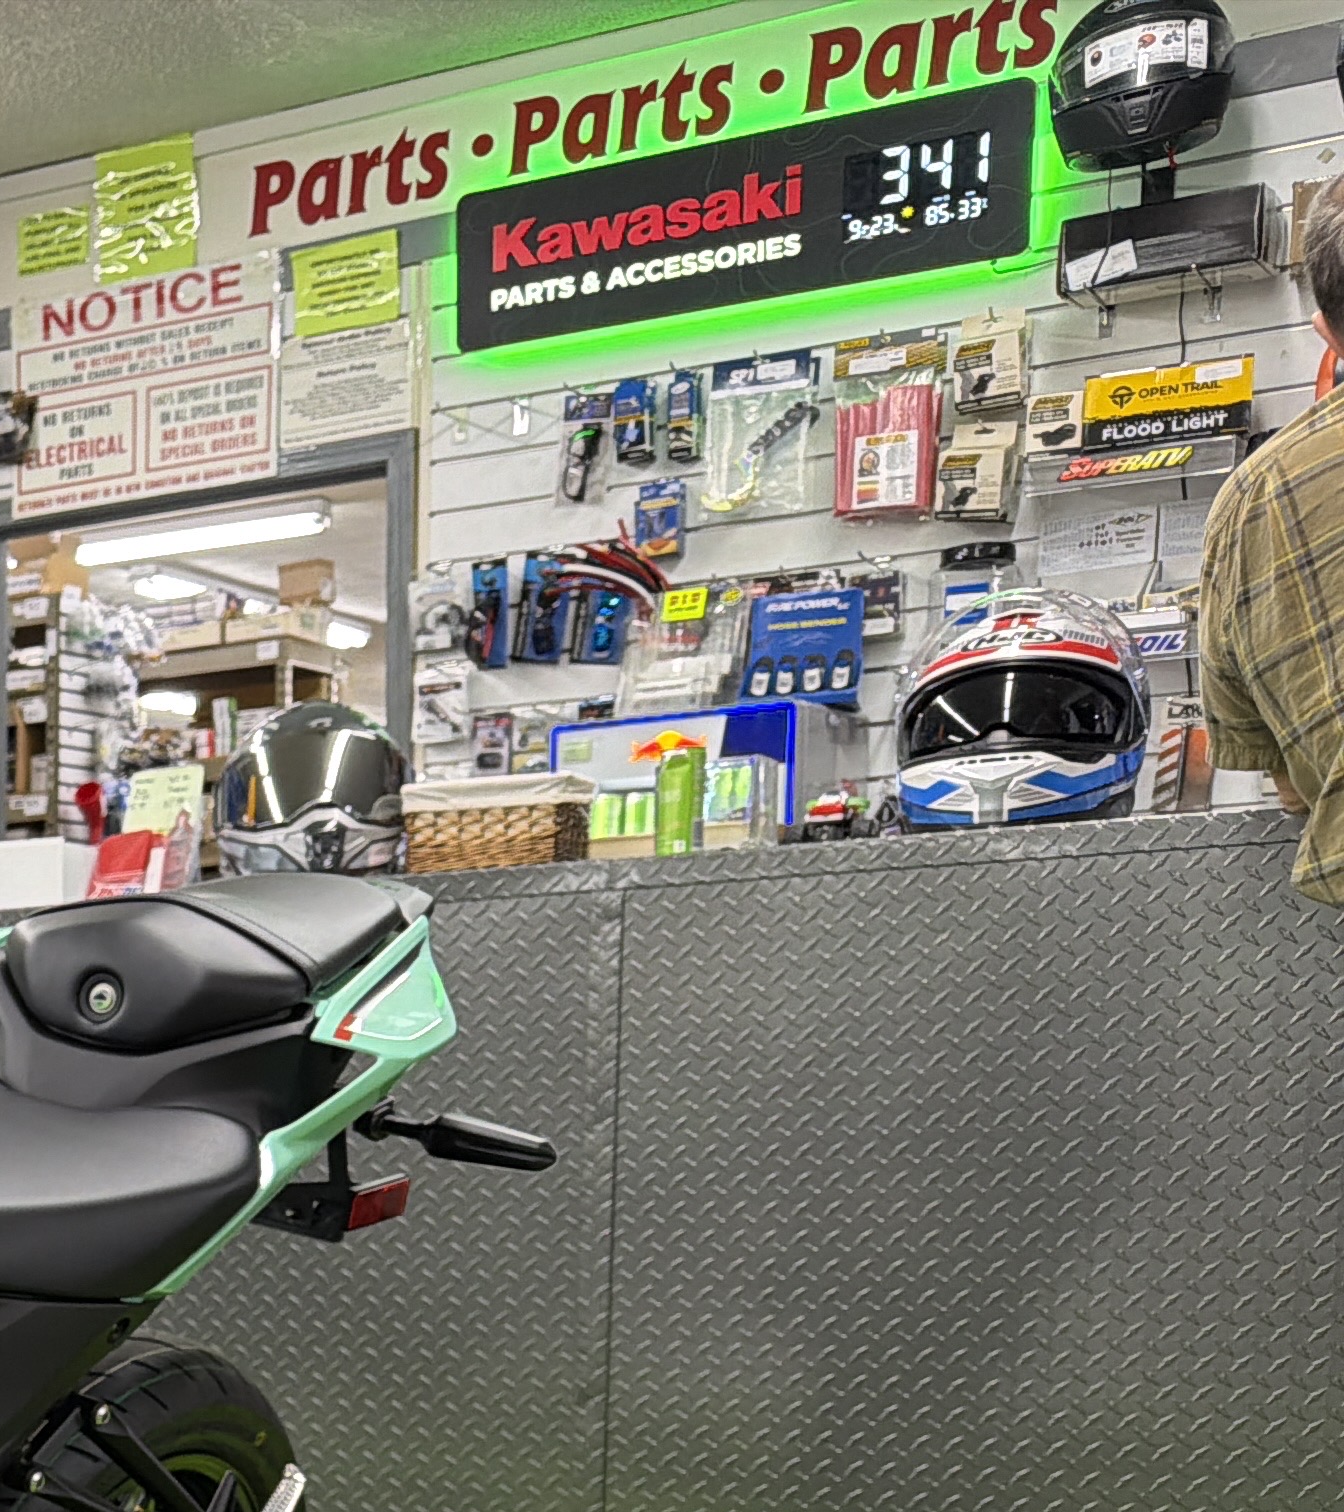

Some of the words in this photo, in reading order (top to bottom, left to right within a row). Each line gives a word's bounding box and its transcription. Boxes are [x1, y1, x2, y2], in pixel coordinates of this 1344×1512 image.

[248, 127, 450, 238] Parts
[507, 58, 734, 177] Parts
[802, 0, 1058, 114] Parts
[492, 164, 803, 273] Kawasaki
[41, 263, 243, 342] NOTICE
[490, 276, 576, 312] PARTS
[580, 270, 600, 294] &
[605, 233, 802, 290] ACCESSORIES
[1102, 421, 1165, 441] FLOOD
[1171, 412, 1228, 432] LIGHT
[1138, 383, 1180, 399] OPEN
[1182, 380, 1223, 393] TRAIL
[1139, 632, 1185, 652] OIL
